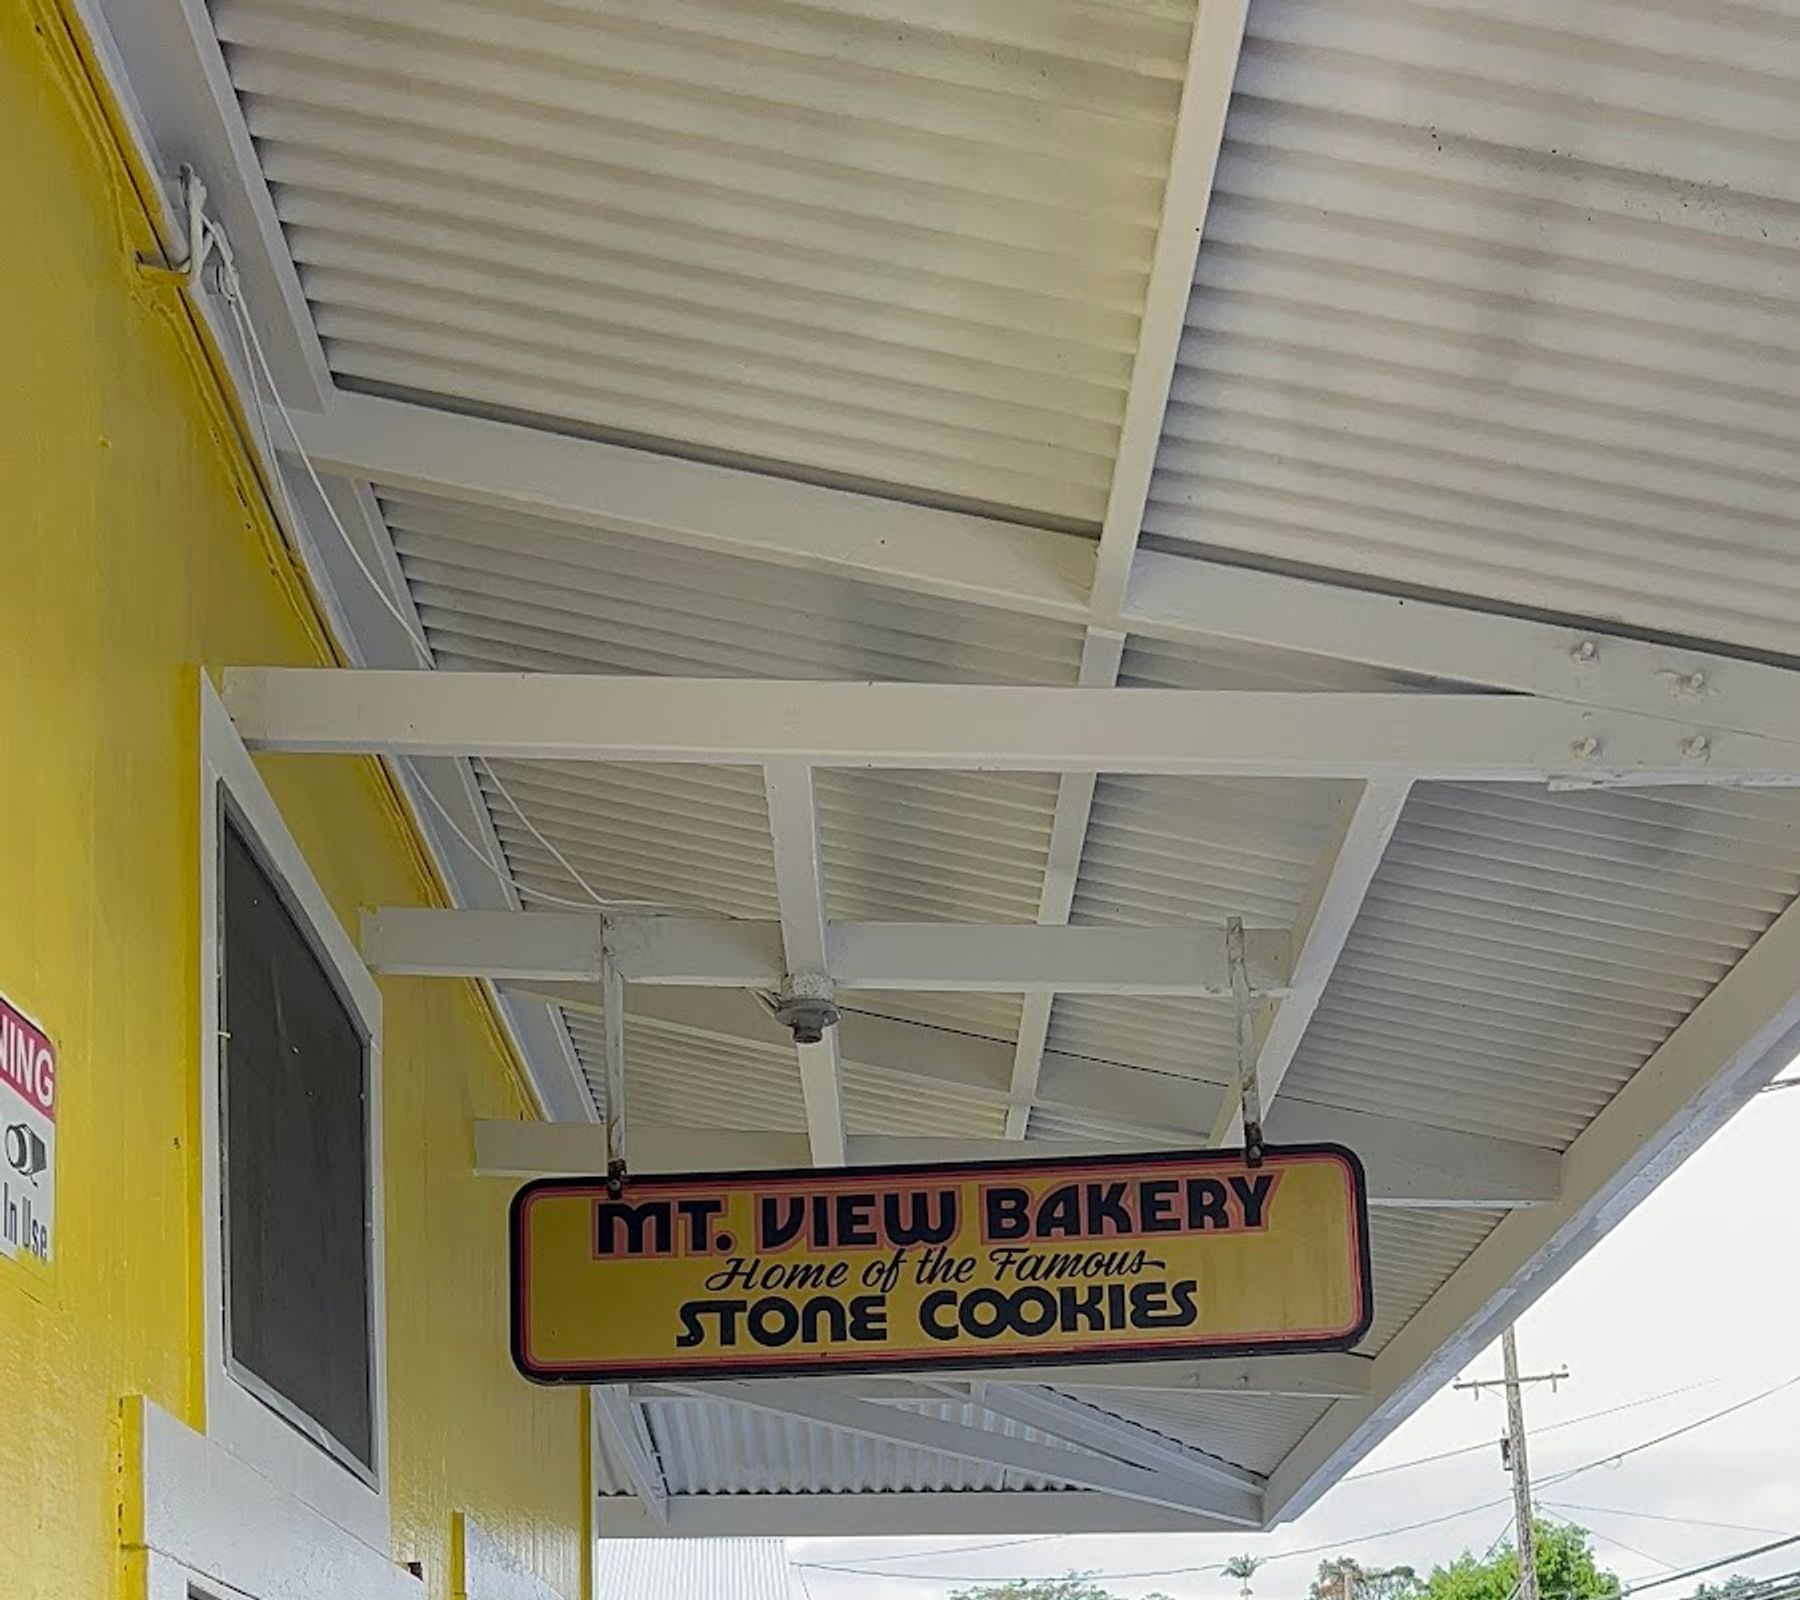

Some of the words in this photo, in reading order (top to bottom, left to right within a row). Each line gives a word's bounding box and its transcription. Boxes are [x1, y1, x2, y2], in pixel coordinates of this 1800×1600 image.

[4, 1181, 17, 1245] In
[22, 1195, 47, 1262] Use
[597, 1199, 732, 1255] MT.
[761, 1190, 957, 1249] VIEW
[986, 1174, 1275, 1240] BAKERY
[705, 1257, 850, 1291] Home
[861, 1249, 908, 1293] of
[915, 1246, 977, 1285] the
[989, 1247, 1166, 1282] Famous
[676, 1292, 888, 1348] STONE
[919, 1280, 1197, 1341] COOKIES
